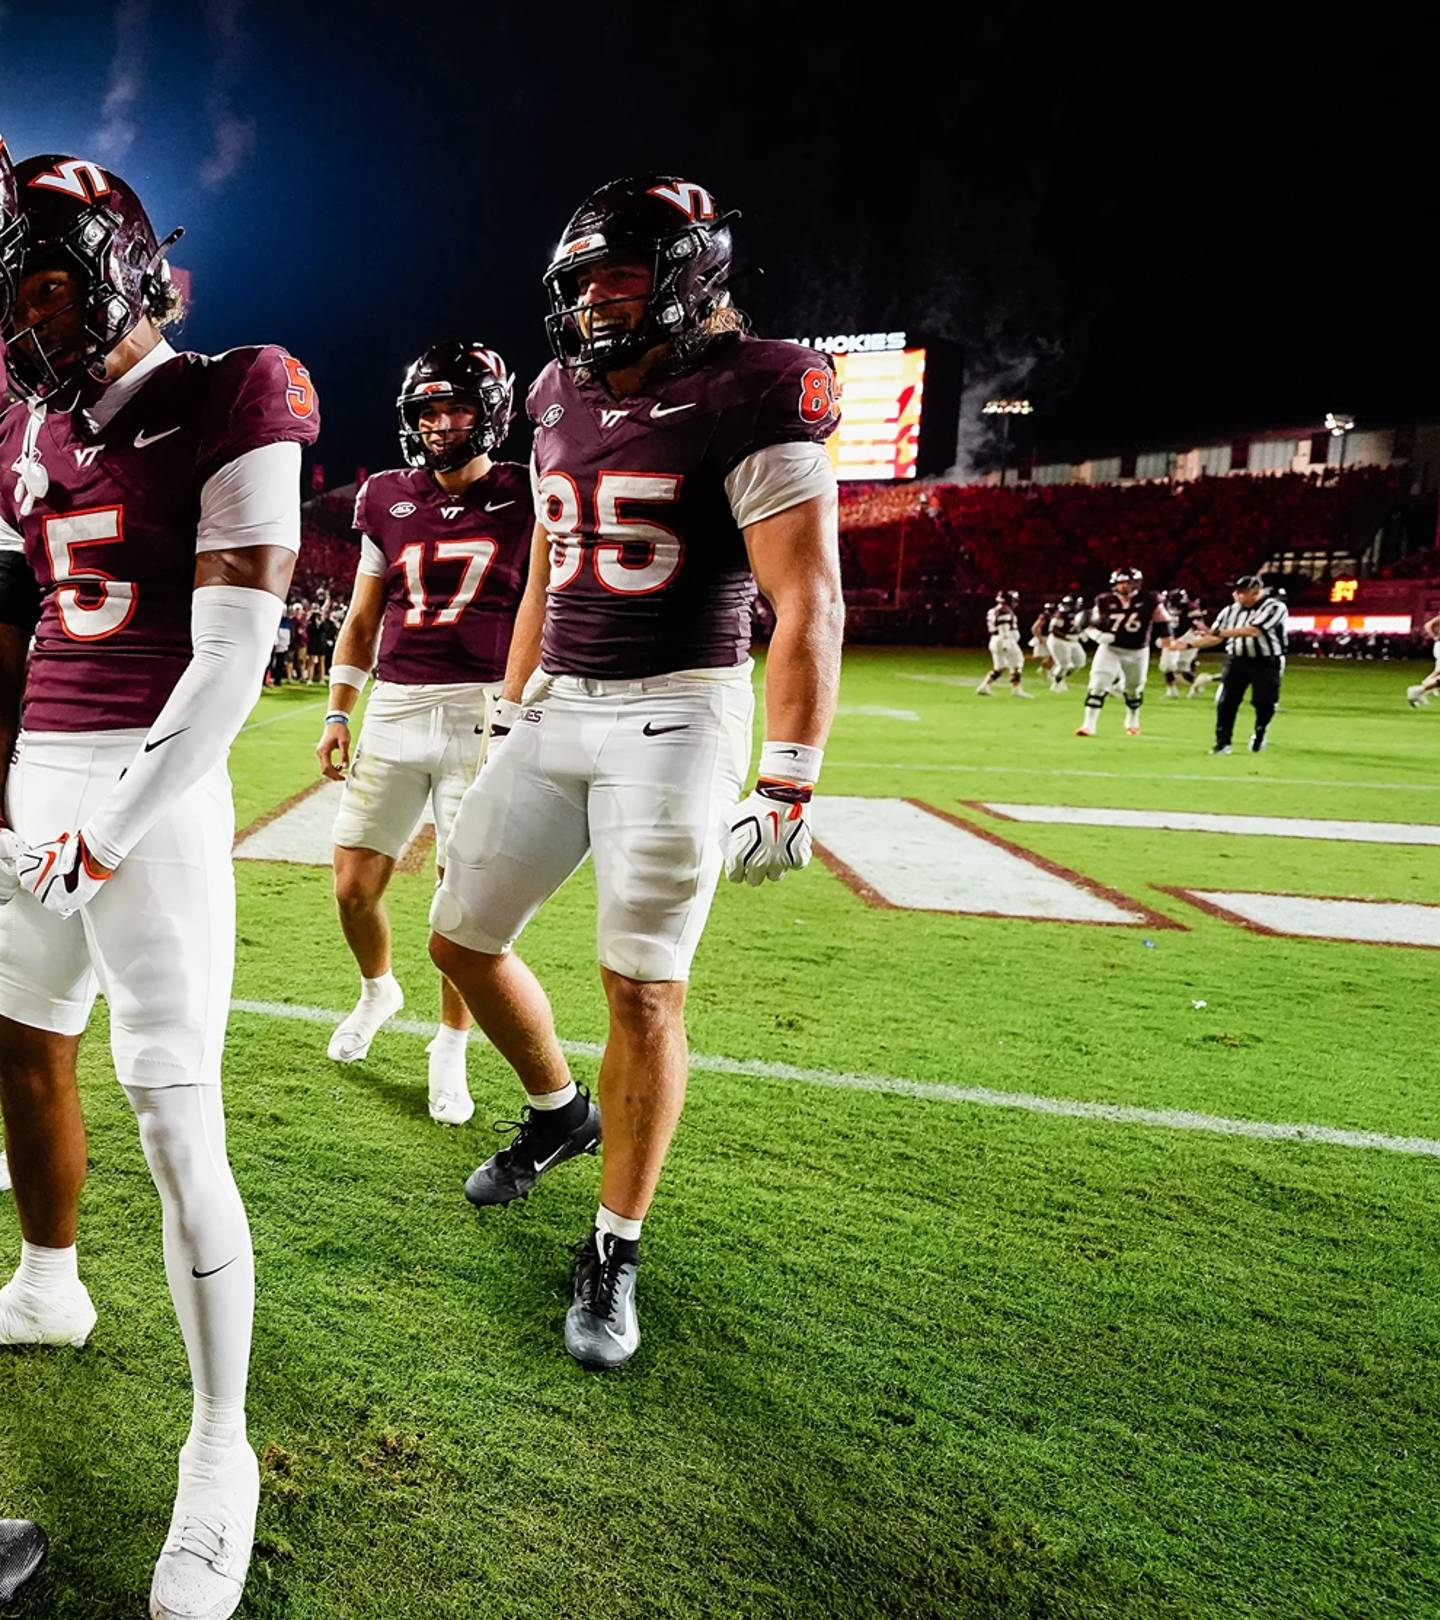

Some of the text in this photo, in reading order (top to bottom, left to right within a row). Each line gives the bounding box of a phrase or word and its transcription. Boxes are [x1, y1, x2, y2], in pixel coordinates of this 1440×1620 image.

[814, 331, 907, 355] HOKIES
[283, 355, 315, 420] 5
[600, 409, 630, 428] VT
[72, 444, 105, 467] VT
[440, 507, 465, 519] VT
[42, 505, 137, 641] 5
[393, 537, 498, 627] 17
[1109, 612, 1141, 632] 76
